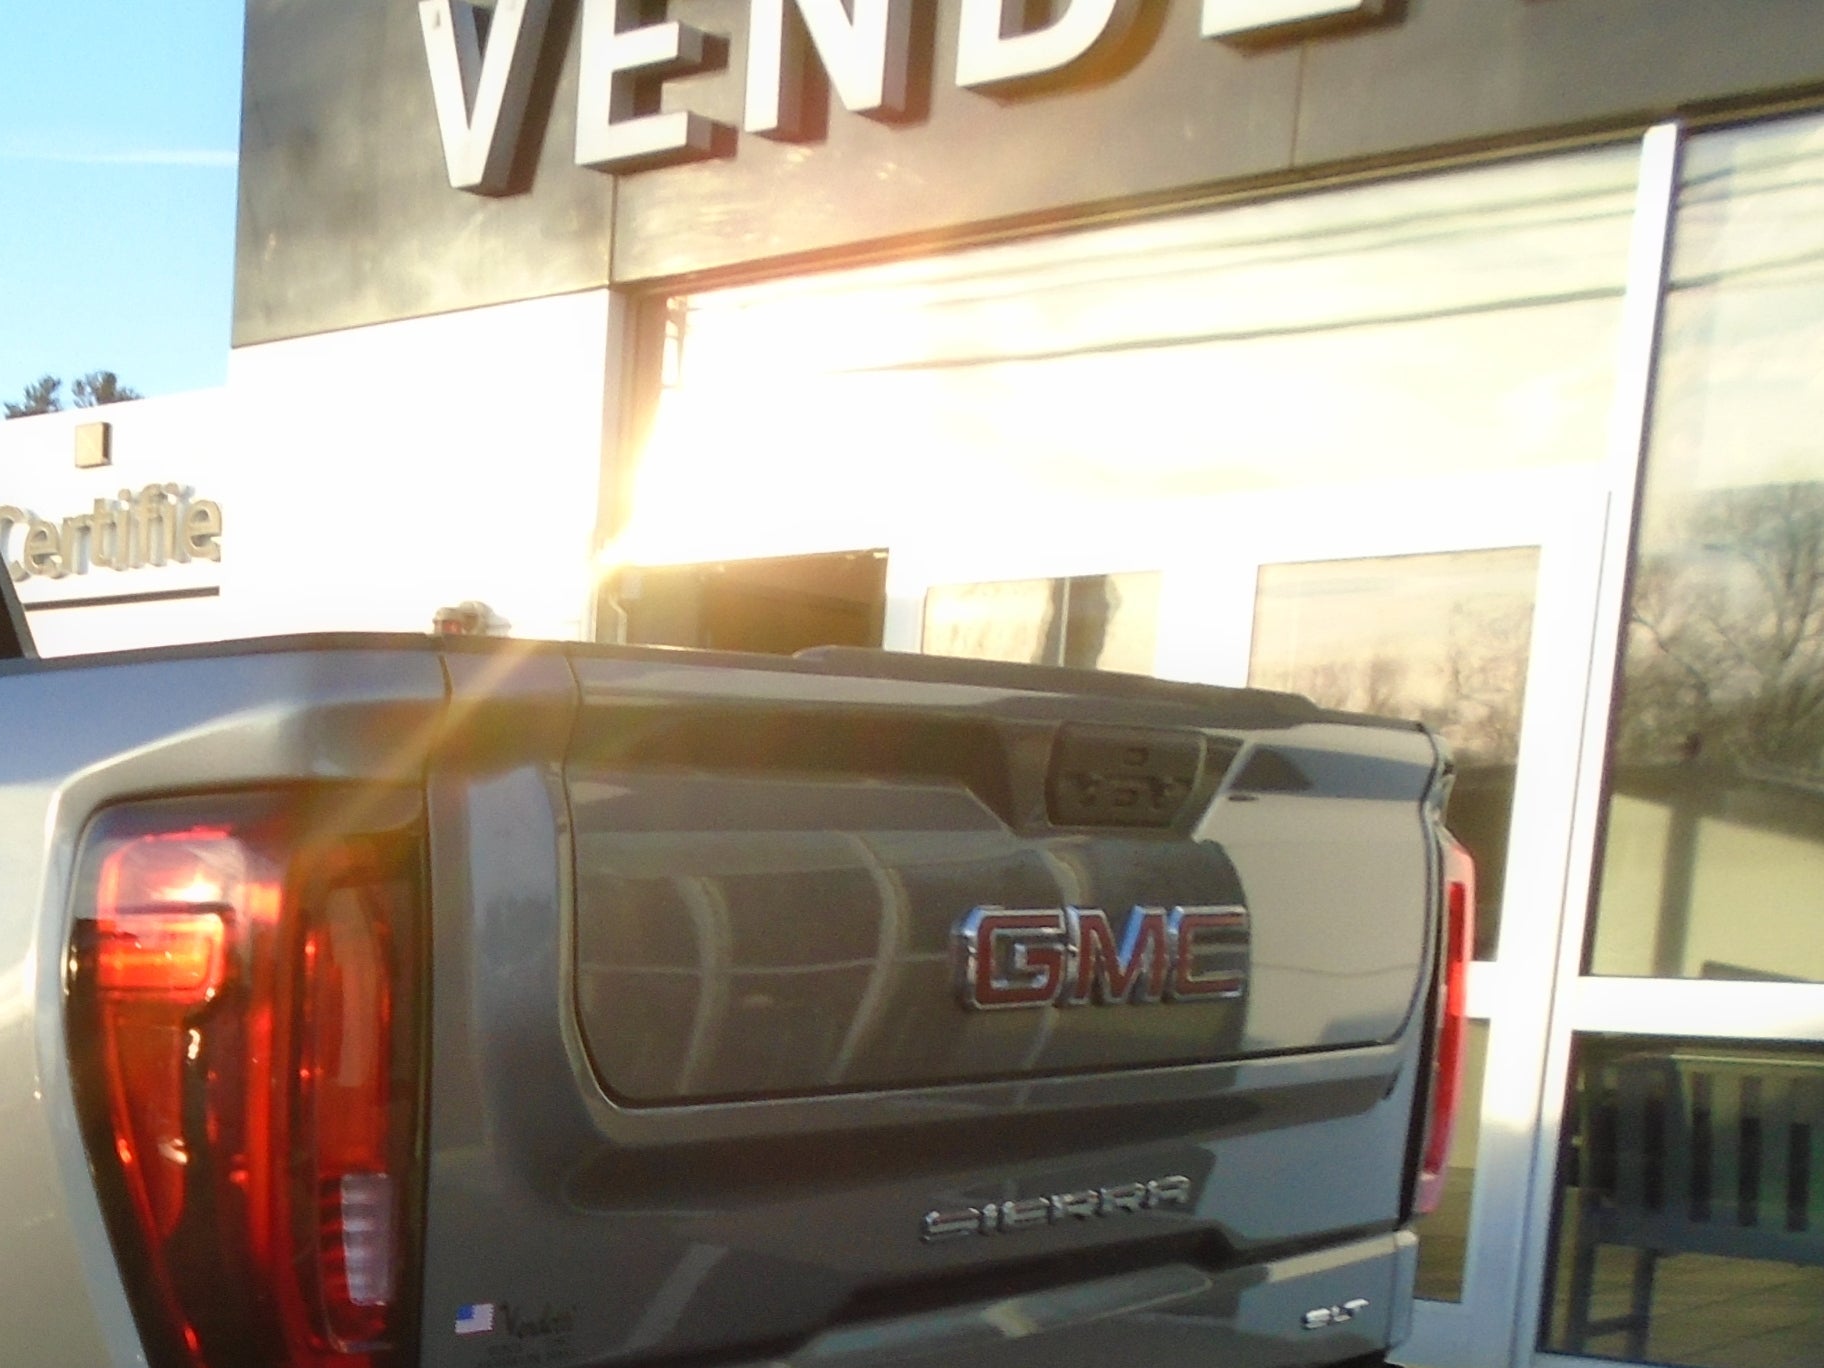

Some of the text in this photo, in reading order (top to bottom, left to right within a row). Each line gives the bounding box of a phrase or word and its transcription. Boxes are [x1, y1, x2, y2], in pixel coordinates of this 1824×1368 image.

[418, 0, 1376, 192] VEN
[956, 904, 1248, 1011] GMC
[922, 1174, 1191, 1241] SIERRA
